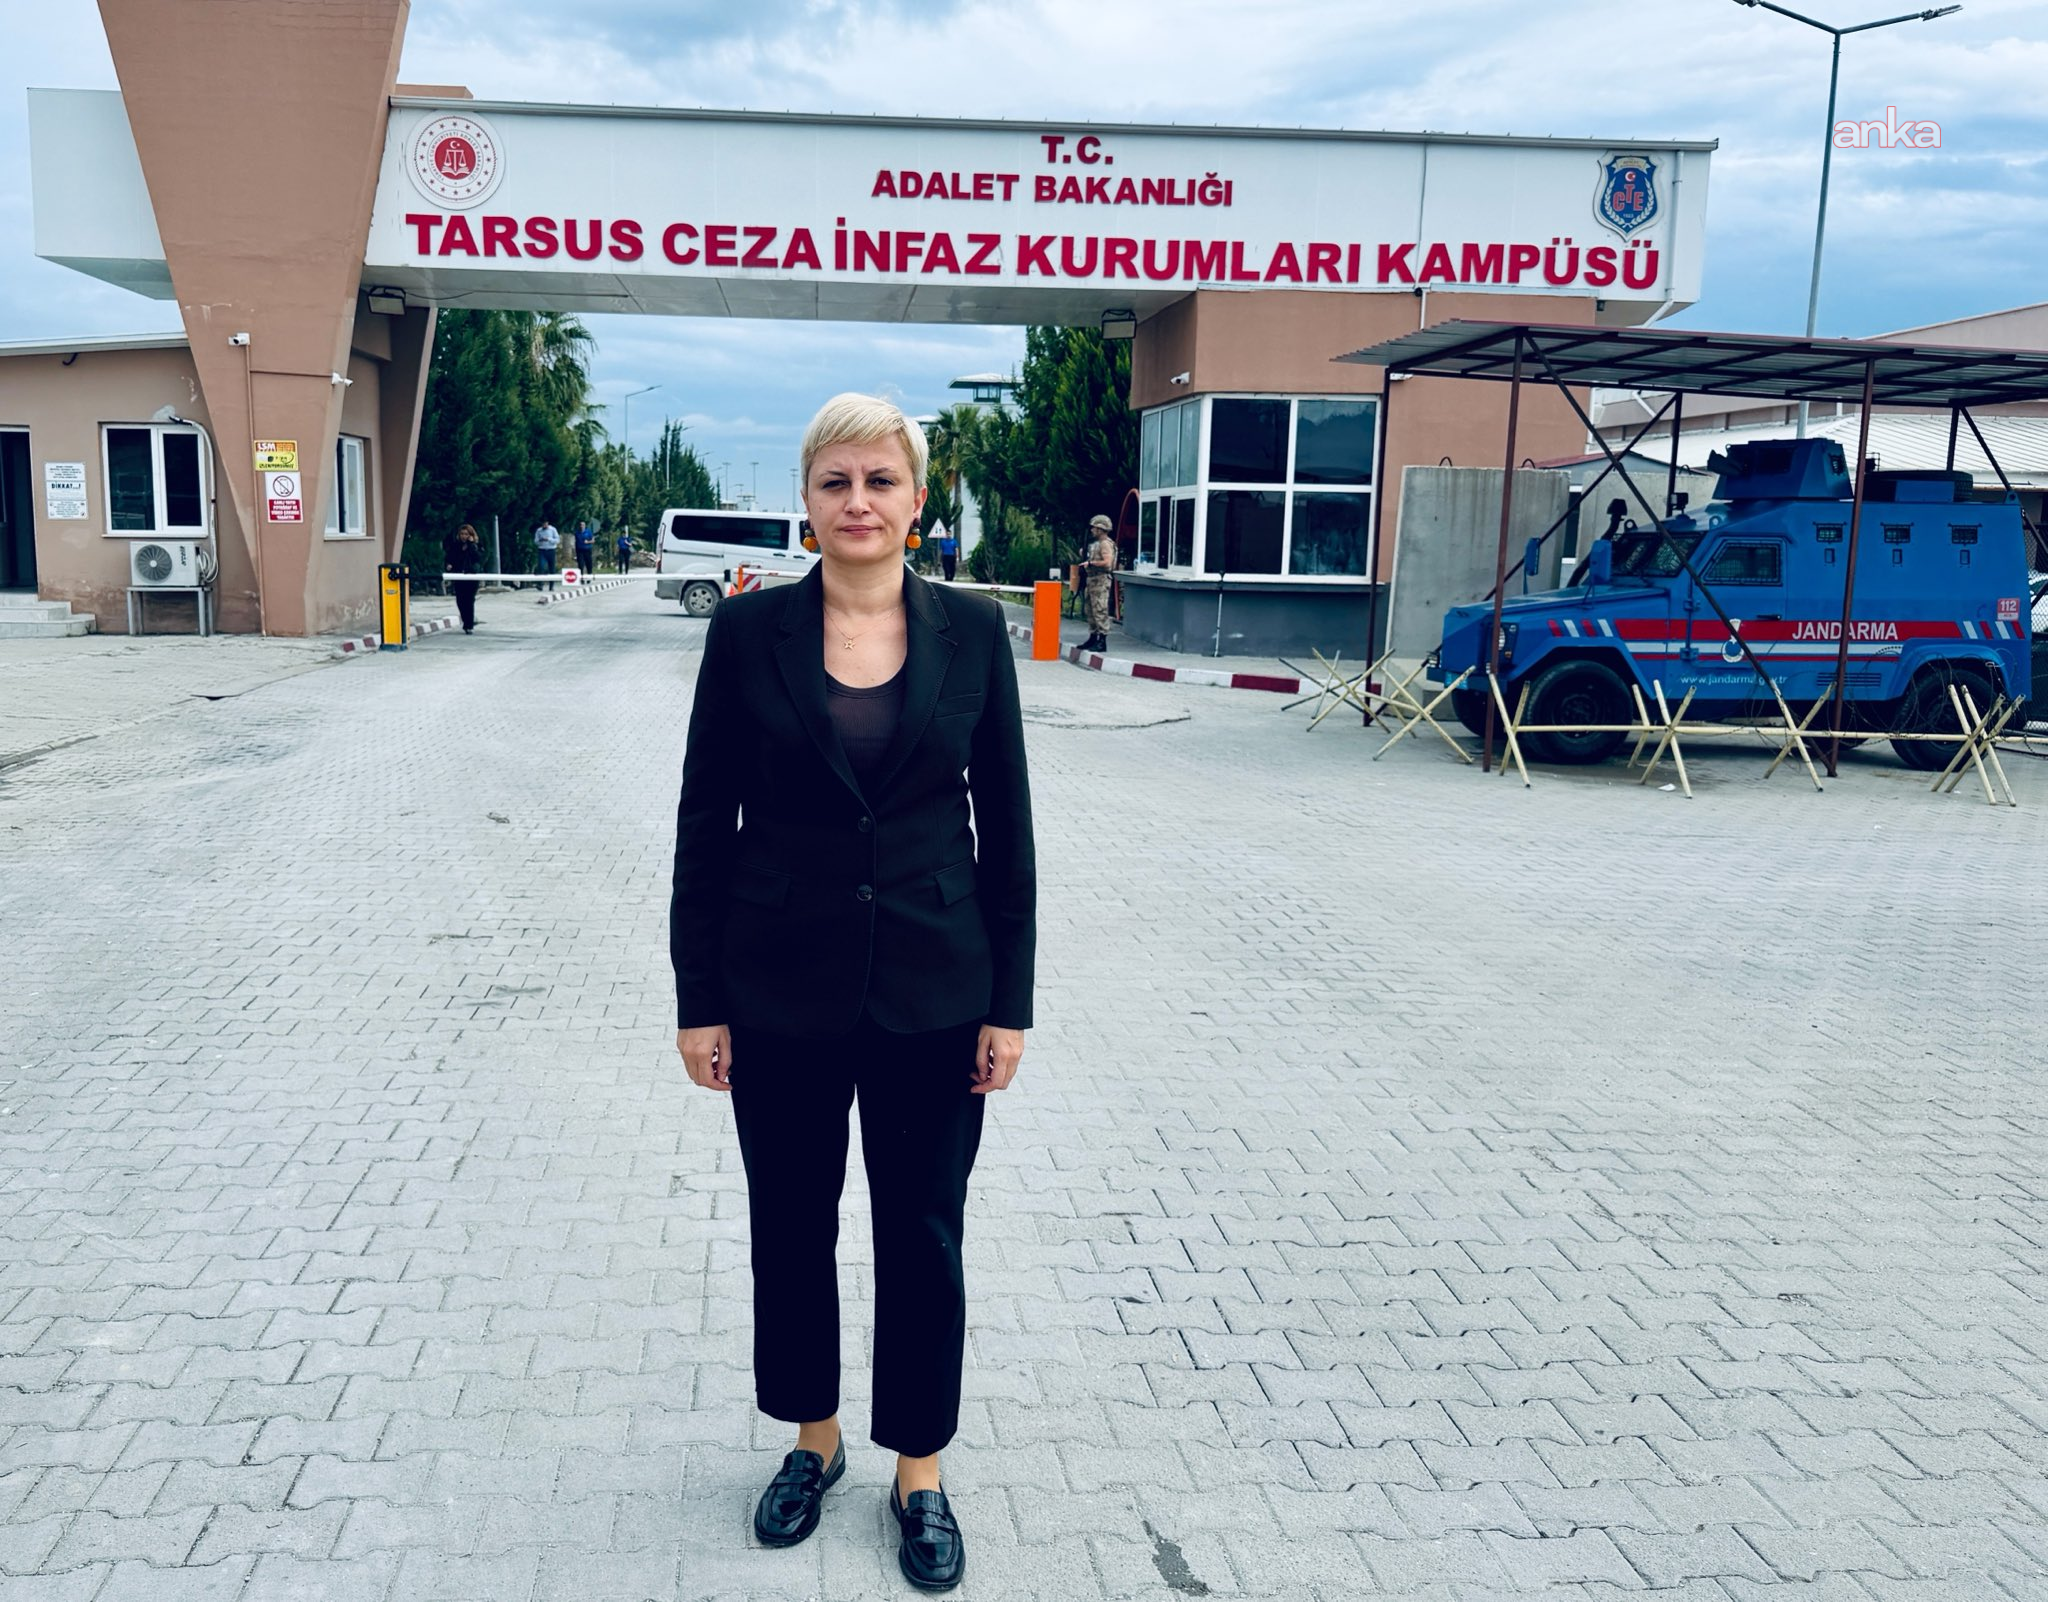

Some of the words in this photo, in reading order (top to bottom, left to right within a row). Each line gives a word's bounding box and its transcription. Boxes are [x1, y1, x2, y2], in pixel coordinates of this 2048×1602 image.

[1041, 135, 1113, 164] T.C.
[872, 170, 1020, 201] ADALET
[1034, 172, 1233, 206] BAKANLIĞI
[405, 213, 644, 261] TARSUS
[662, 222, 822, 270] CEZA
[834, 216, 1001, 274] İNFAZ
[1016, 235, 1361, 283] KURUMLARI
[1377, 238, 1660, 290] KAMPÜSÜ
[2000, 600, 2017, 612] 112
[1792, 622, 1898, 640] JANDARMA
[1680, 674, 1787, 686] www.jandarmgv.tr
